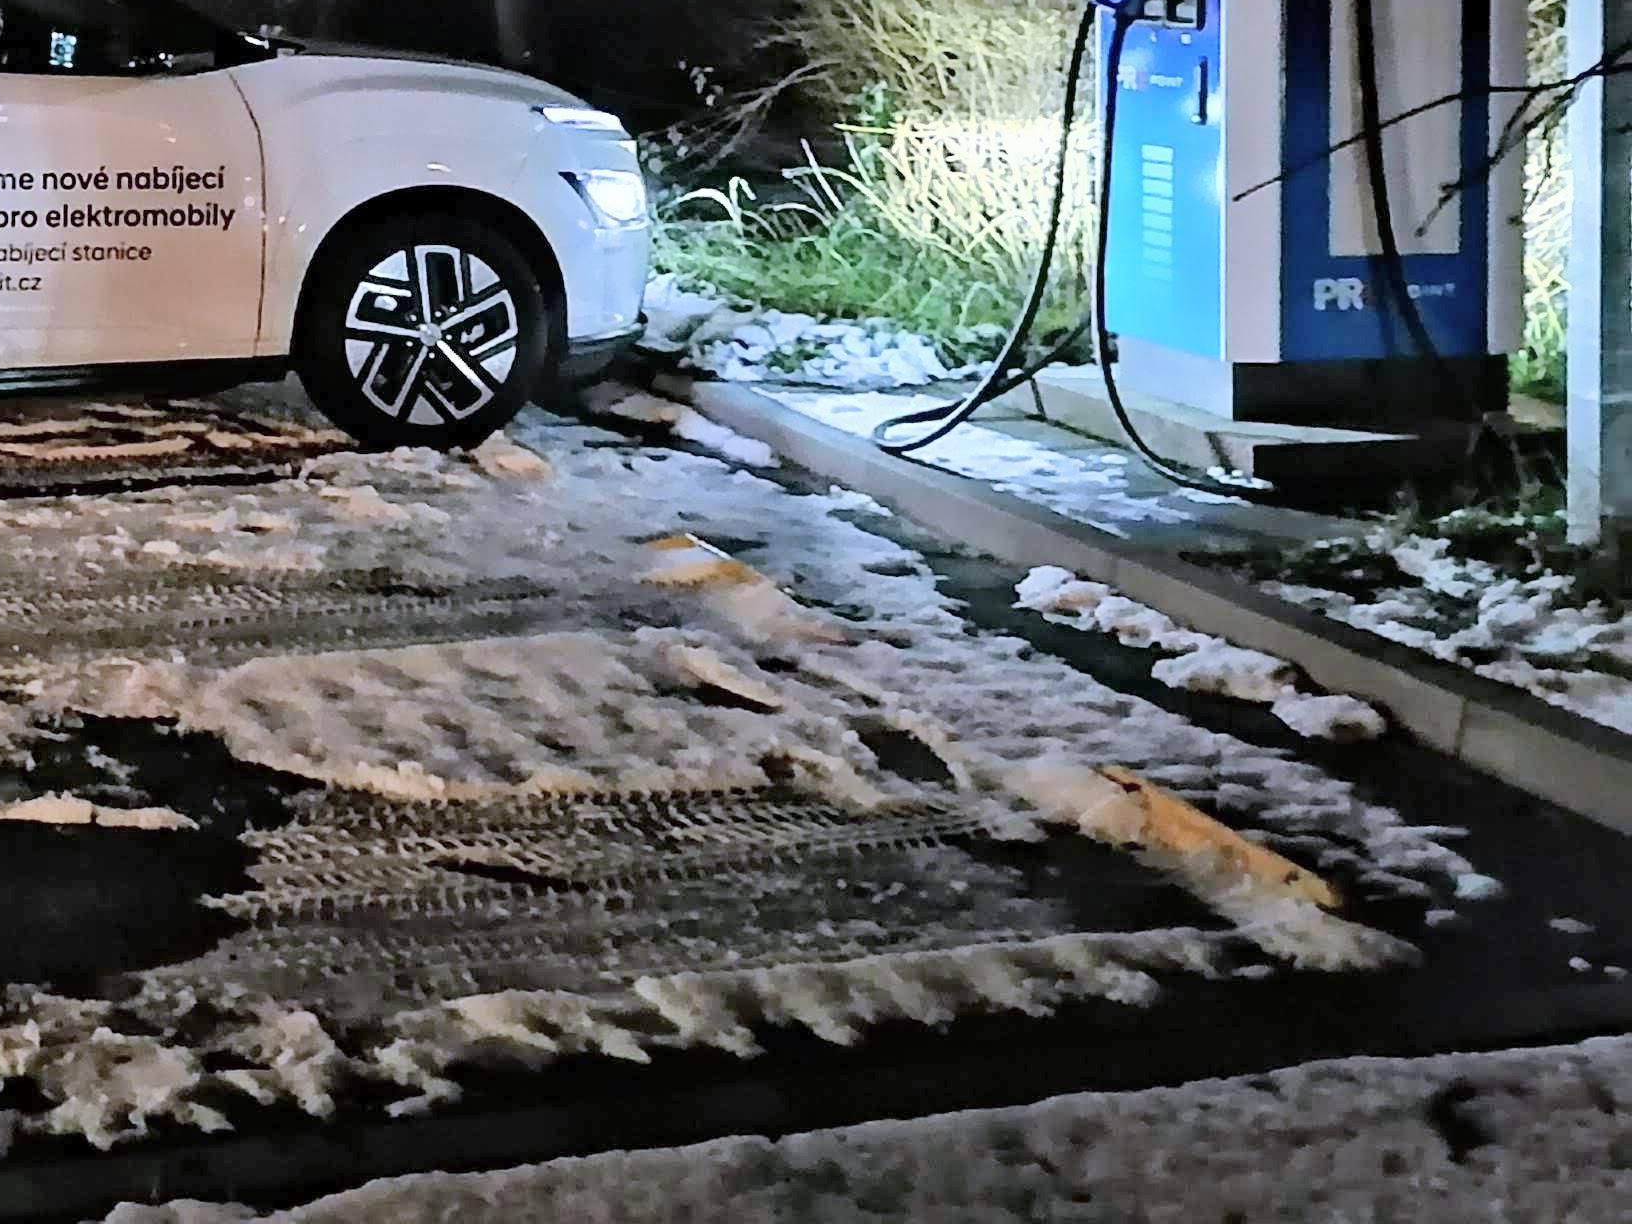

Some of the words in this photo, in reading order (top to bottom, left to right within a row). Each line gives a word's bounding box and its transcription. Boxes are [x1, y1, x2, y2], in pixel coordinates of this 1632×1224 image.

[41, 166, 109, 191] nové
[116, 165, 226, 194] nabíjecí
[44, 203, 236, 231] elektromobily
[71, 241, 153, 261] stanice
